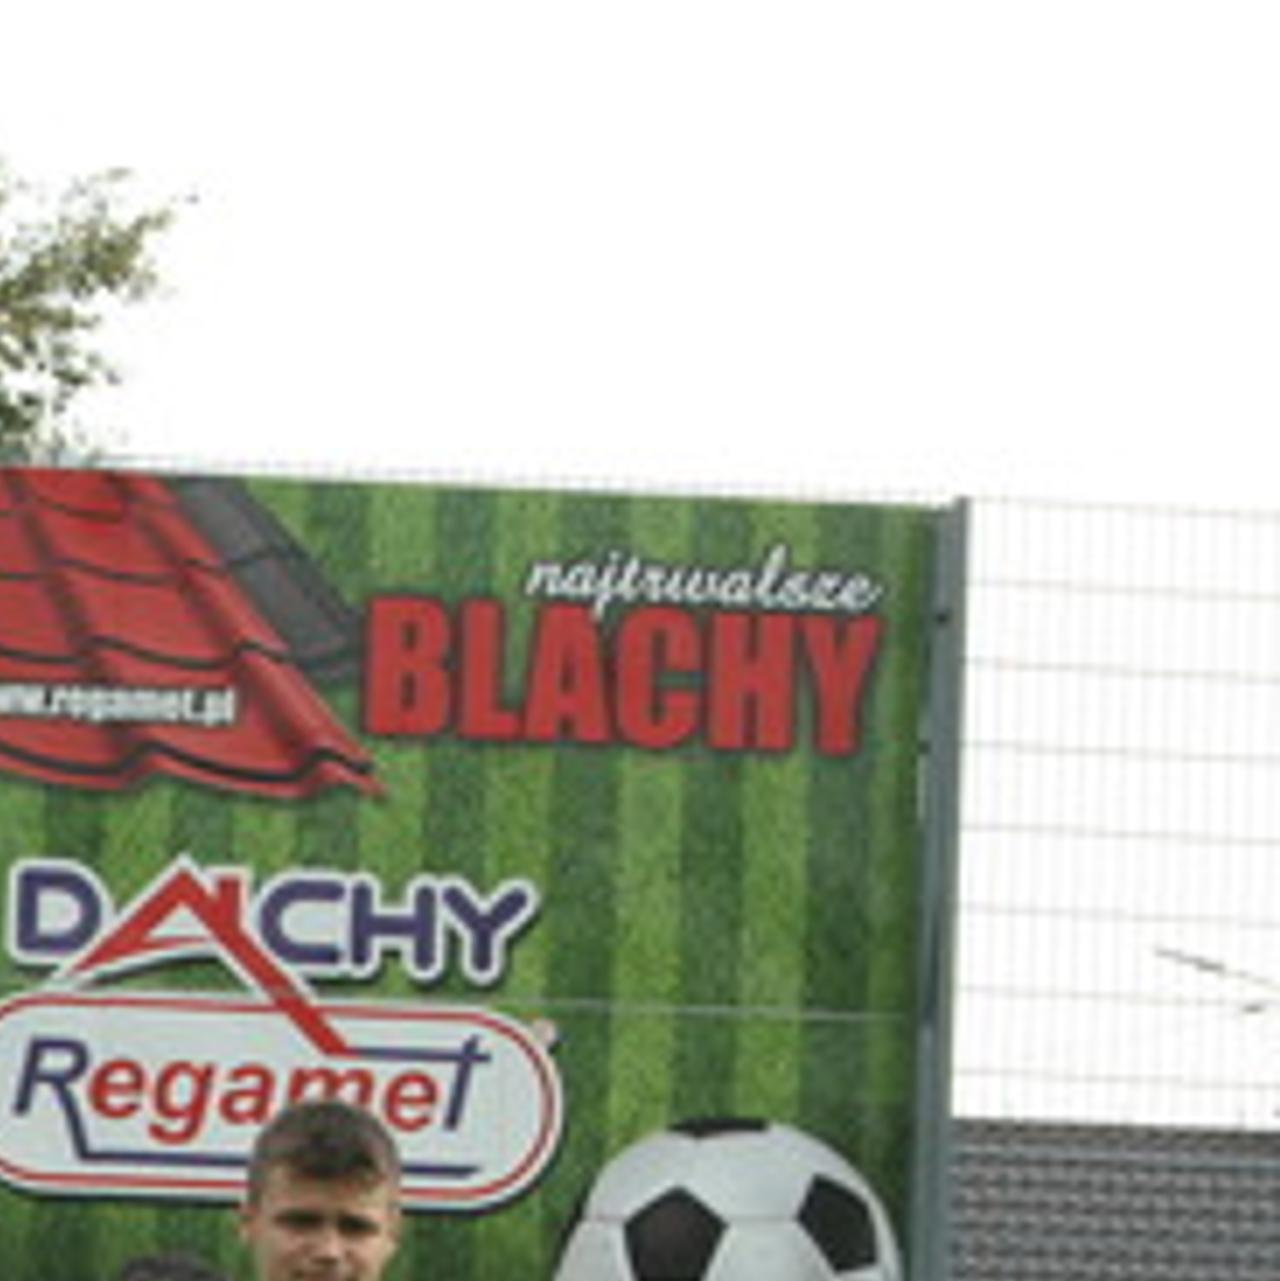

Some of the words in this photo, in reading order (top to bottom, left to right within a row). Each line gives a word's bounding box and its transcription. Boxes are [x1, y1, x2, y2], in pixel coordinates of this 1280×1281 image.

[363, 596, 885, 757] BLACHY
[8, 856, 536, 978] DACHY
[12, 1034, 494, 1152] Regamet
